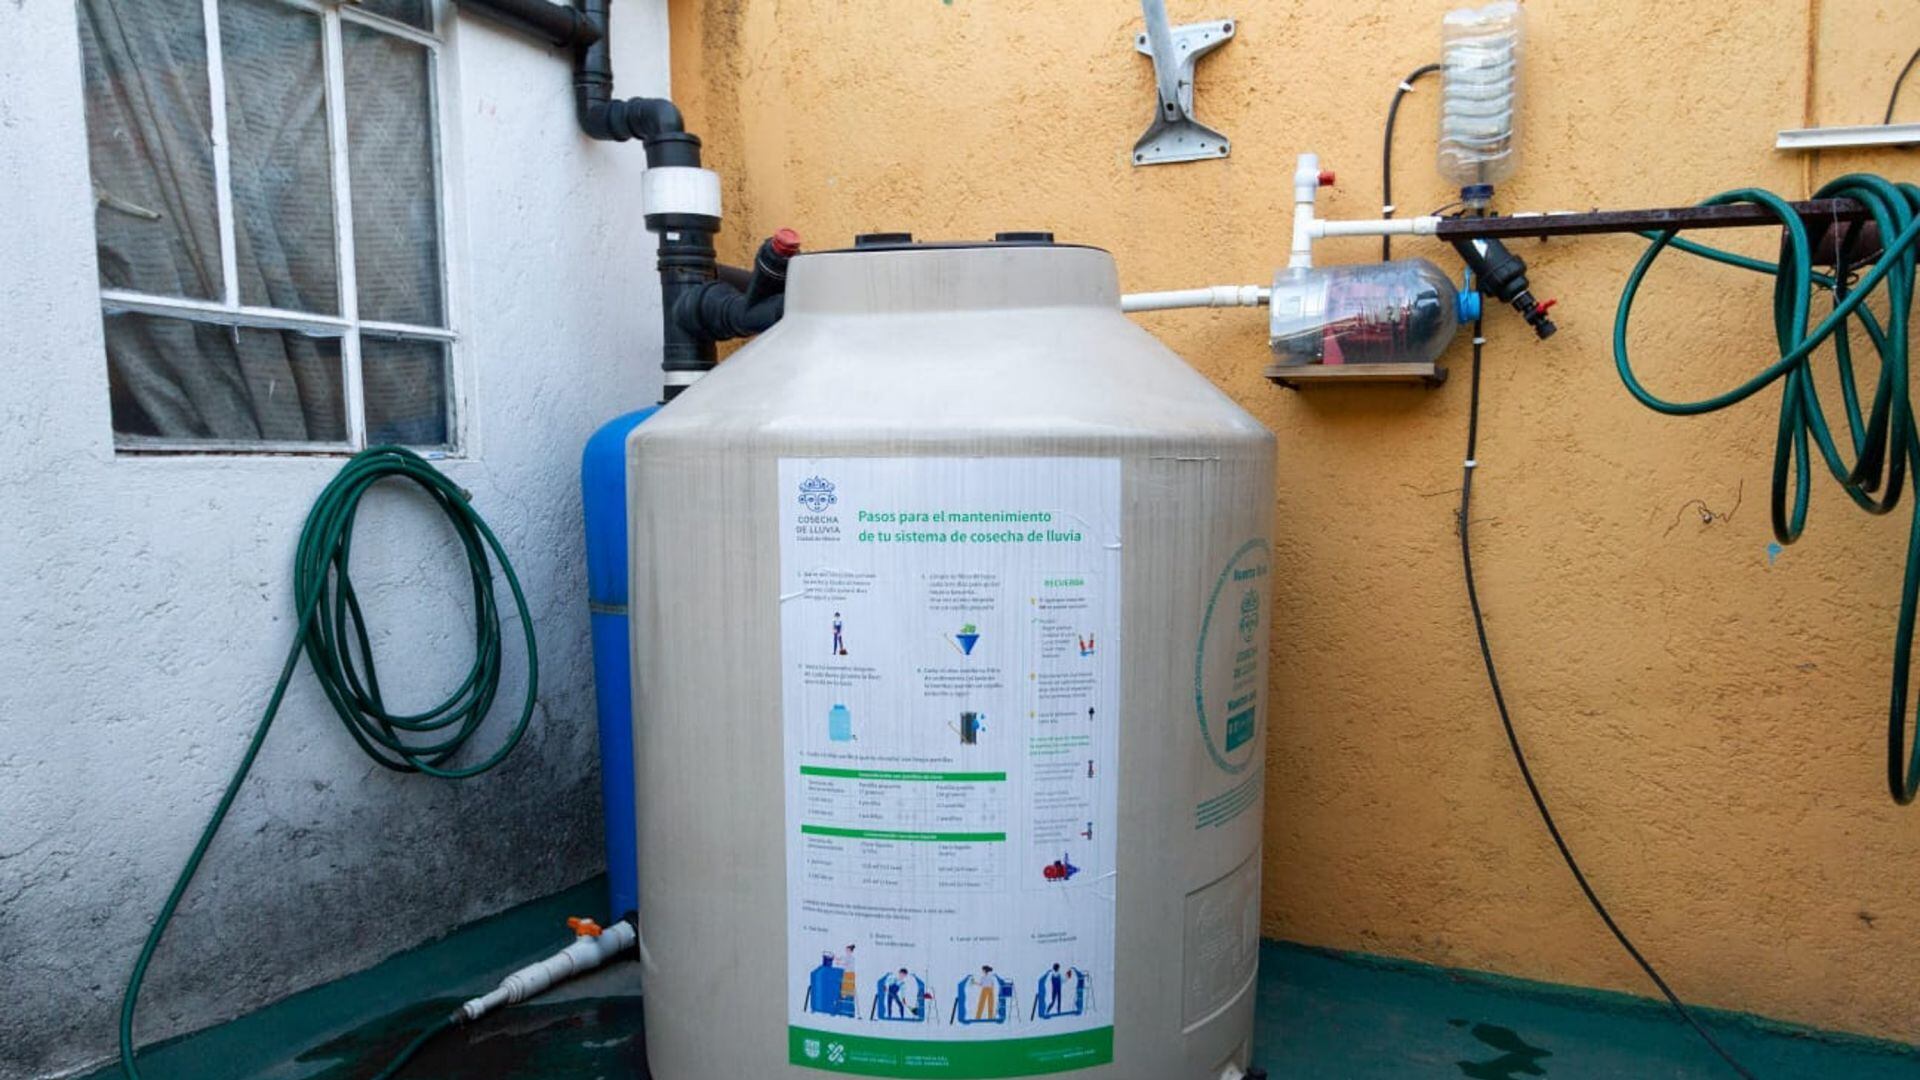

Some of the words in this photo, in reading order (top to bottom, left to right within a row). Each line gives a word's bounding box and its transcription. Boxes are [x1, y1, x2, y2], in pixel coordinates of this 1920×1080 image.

[797, 515, 840, 524] COSECHA
[858, 510, 896, 523] Pasos
[899, 513, 930, 525] para
[933, 511, 946, 522] el
[949, 511, 1051, 523] mantenimiento
[796, 525, 807, 535] DE
[809, 526, 841, 534] LLUVIA
[858, 530, 875, 543] de
[878, 531, 892, 543] tu
[895, 531, 948, 543] sistema
[950, 530, 968, 543] de
[971, 530, 1025, 543] cosecha
[1027, 530, 1044, 543] de
[1047, 530, 1083, 542] lluvia
